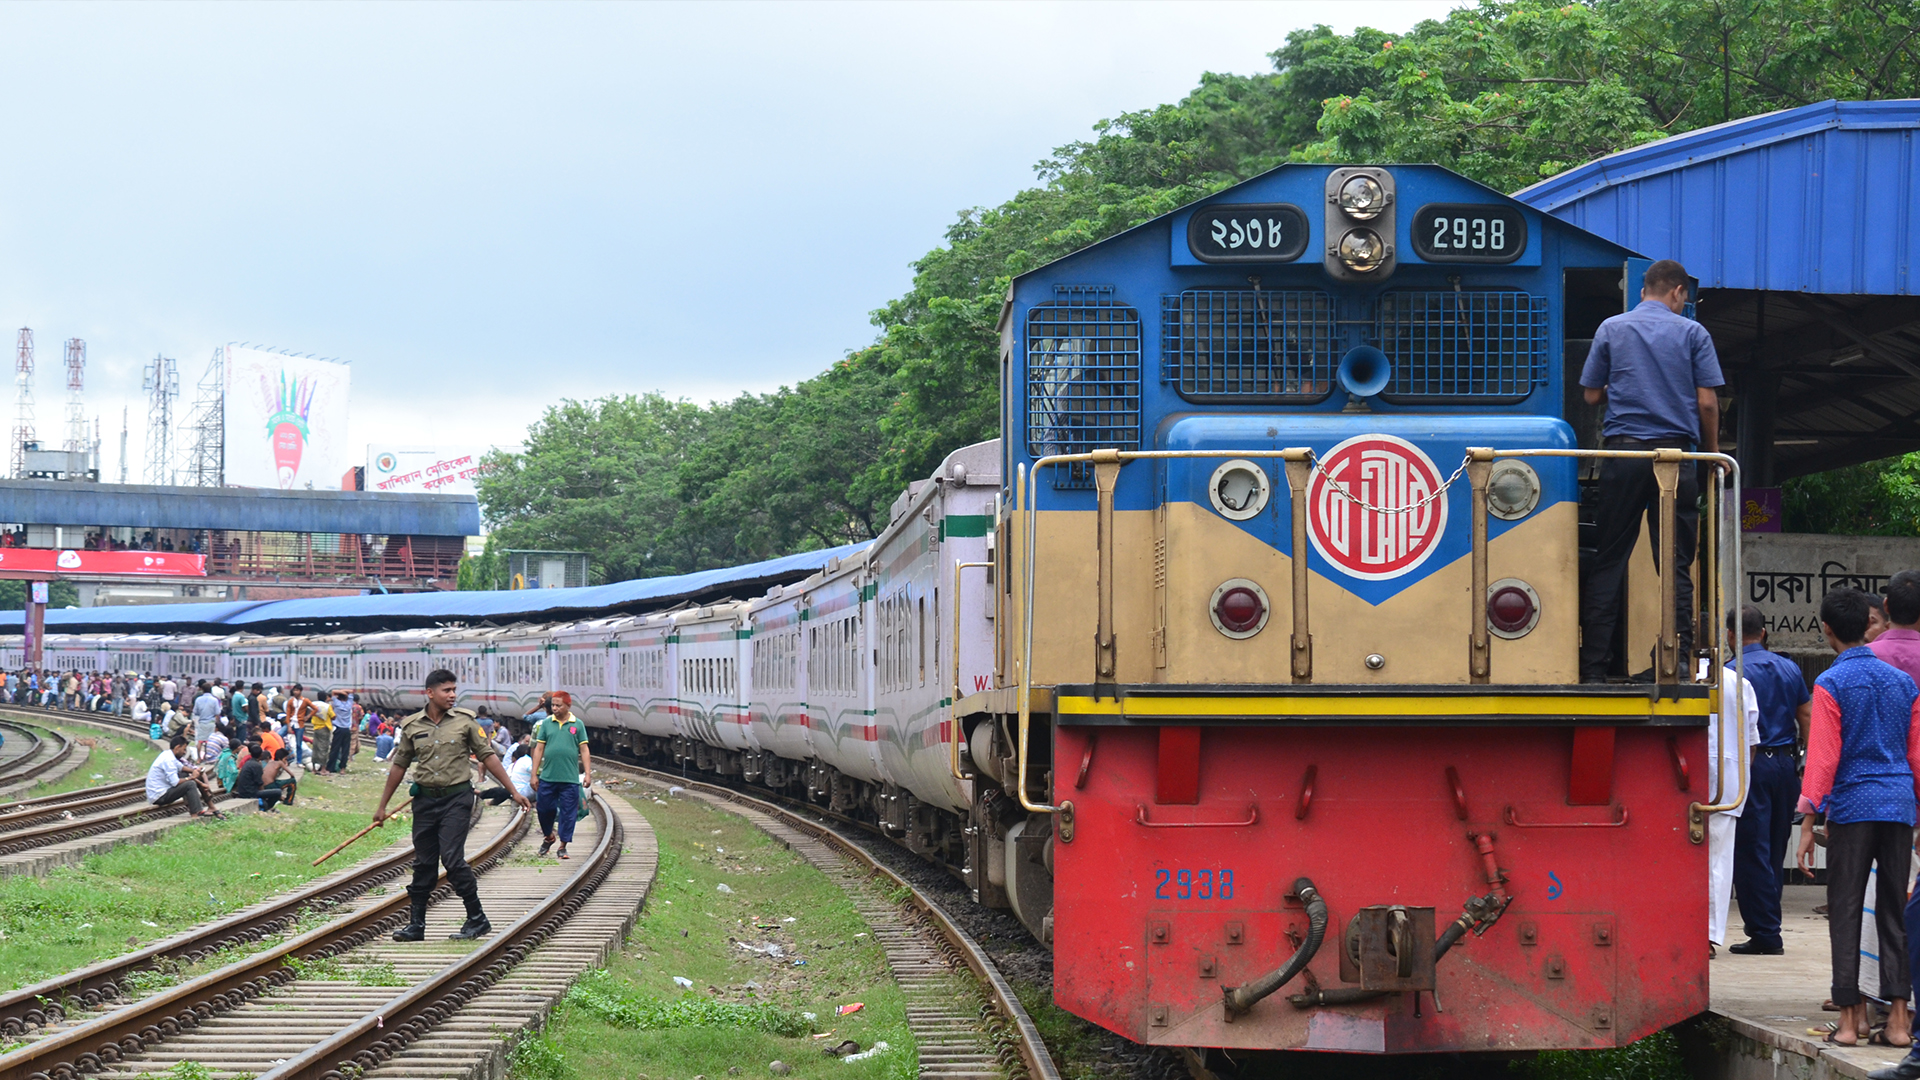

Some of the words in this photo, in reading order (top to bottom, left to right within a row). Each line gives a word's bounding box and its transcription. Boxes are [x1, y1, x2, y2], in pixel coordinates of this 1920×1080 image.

[1433, 217, 1505, 250] 2938
[376, 470, 423, 491] আশিয়ান
[425, 454, 473, 477] মেডিকেল
[422, 473, 456, 490] কলেজ
[1746, 571, 1815, 604] ঢাকা
[1763, 615, 1822, 633] HAKA
[1155, 869, 1235, 900] 2938
